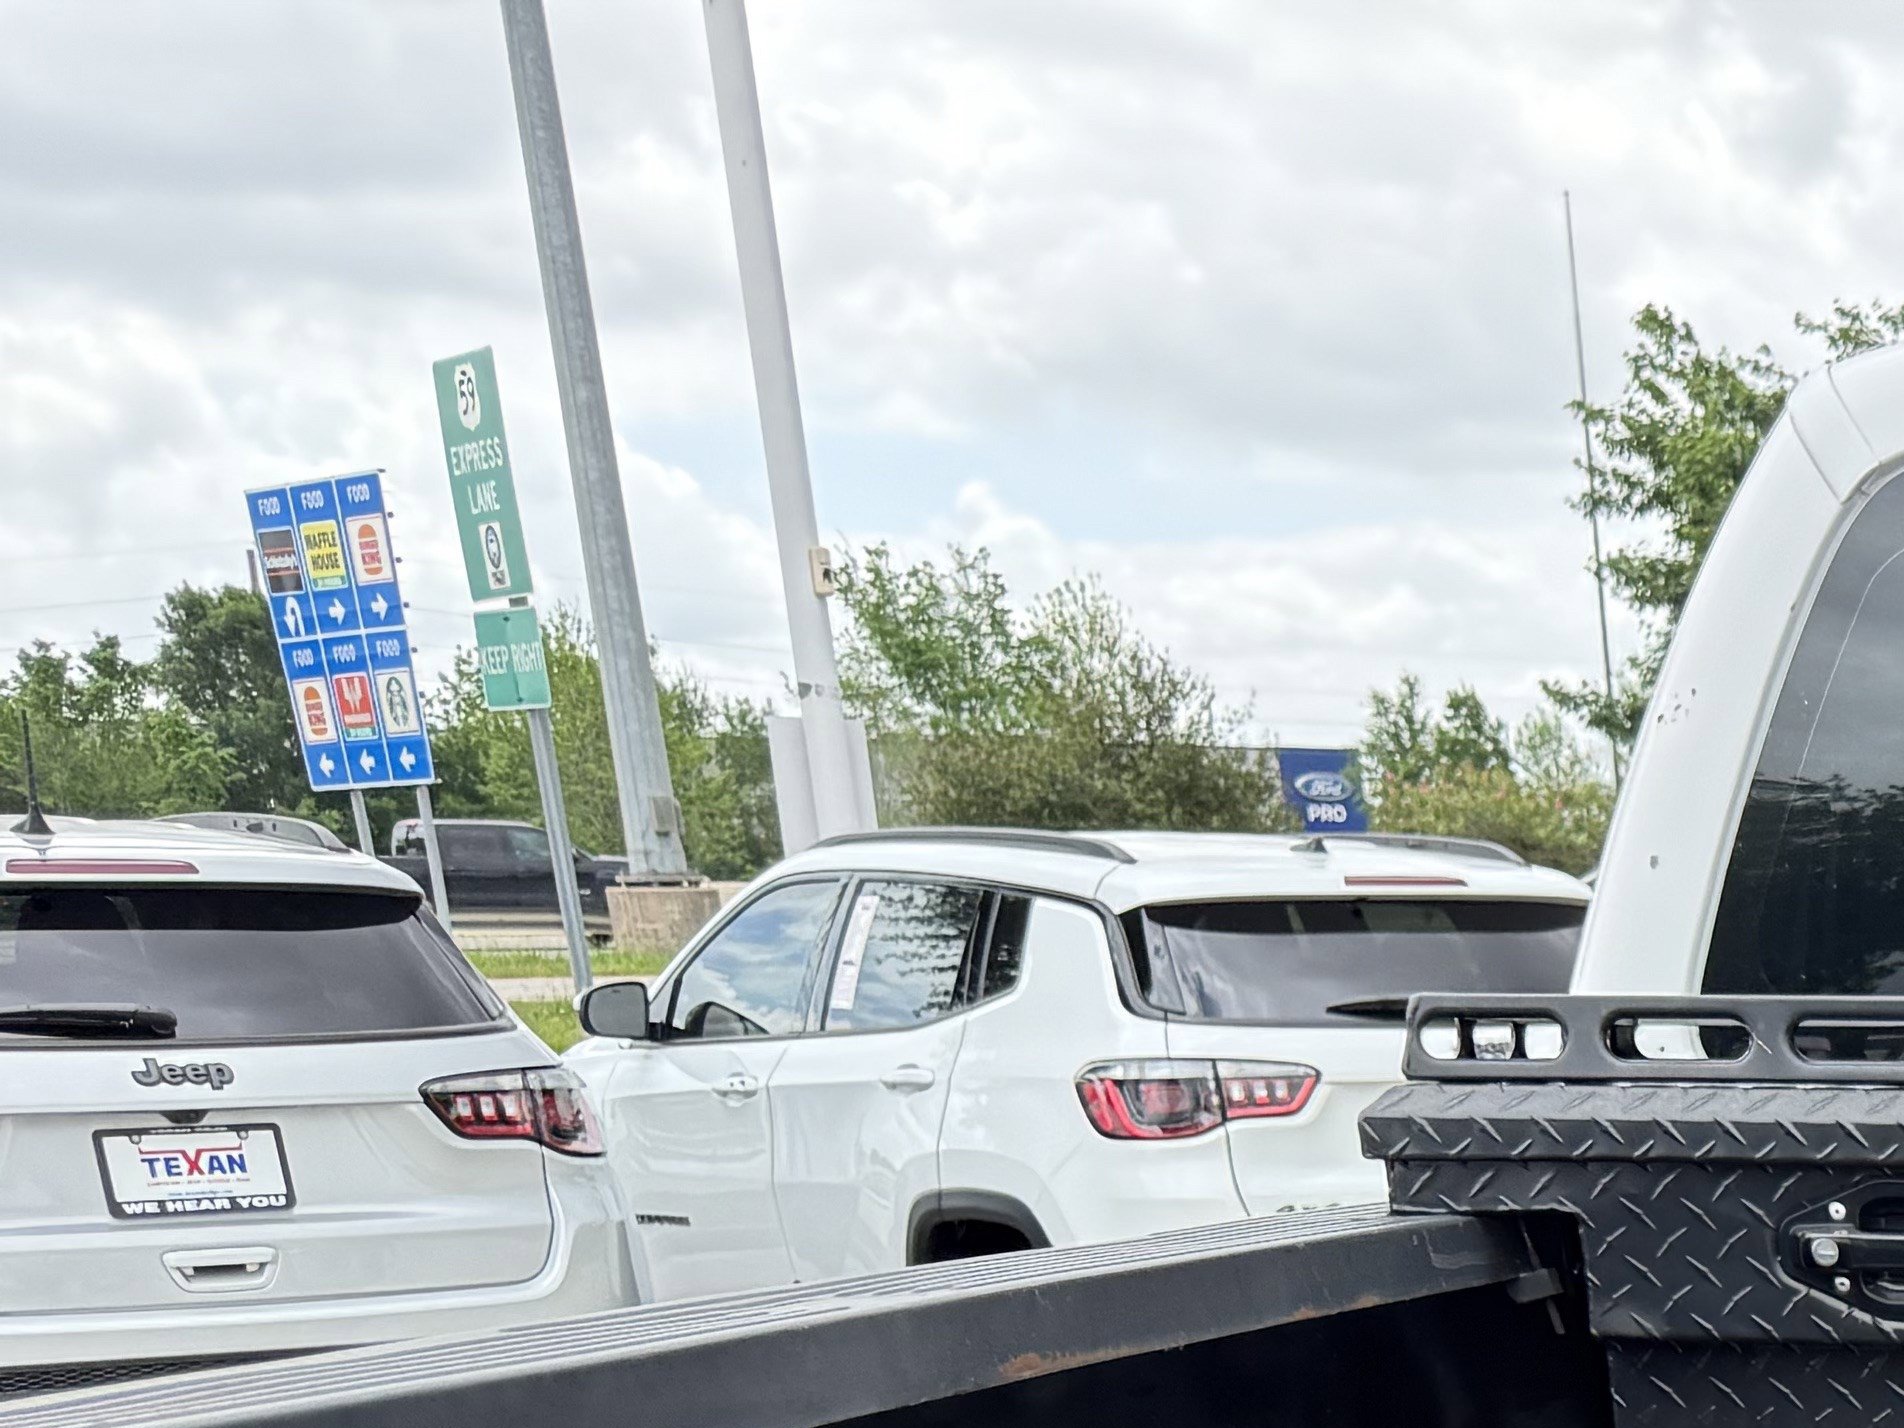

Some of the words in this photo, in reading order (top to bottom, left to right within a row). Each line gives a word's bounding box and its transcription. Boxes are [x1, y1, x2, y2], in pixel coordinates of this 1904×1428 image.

[458, 370, 476, 416] 59
[450, 436, 503, 476] EXPRESS
[301, 489, 324, 510] FOOD
[346, 483, 370, 504] FOOD
[467, 480, 501, 515] LANE
[257, 496, 281, 516] FOOD
[311, 552, 341, 571] HOUSE
[292, 647, 314, 668] FOOD
[332, 643, 356, 663] FOOD
[375, 638, 400, 658] FOOD
[480, 644, 510, 675] KEEP
[510, 641, 545, 673] RIGHT
[1306, 802, 1347, 823] PRO
[131, 1058, 235, 1091] Jeep
[139, 1149, 249, 1179] TEXAN
[121, 1201, 161, 1215] WE
[166, 1197, 231, 1213] HEAR
[235, 1195, 287, 1209] YOU
